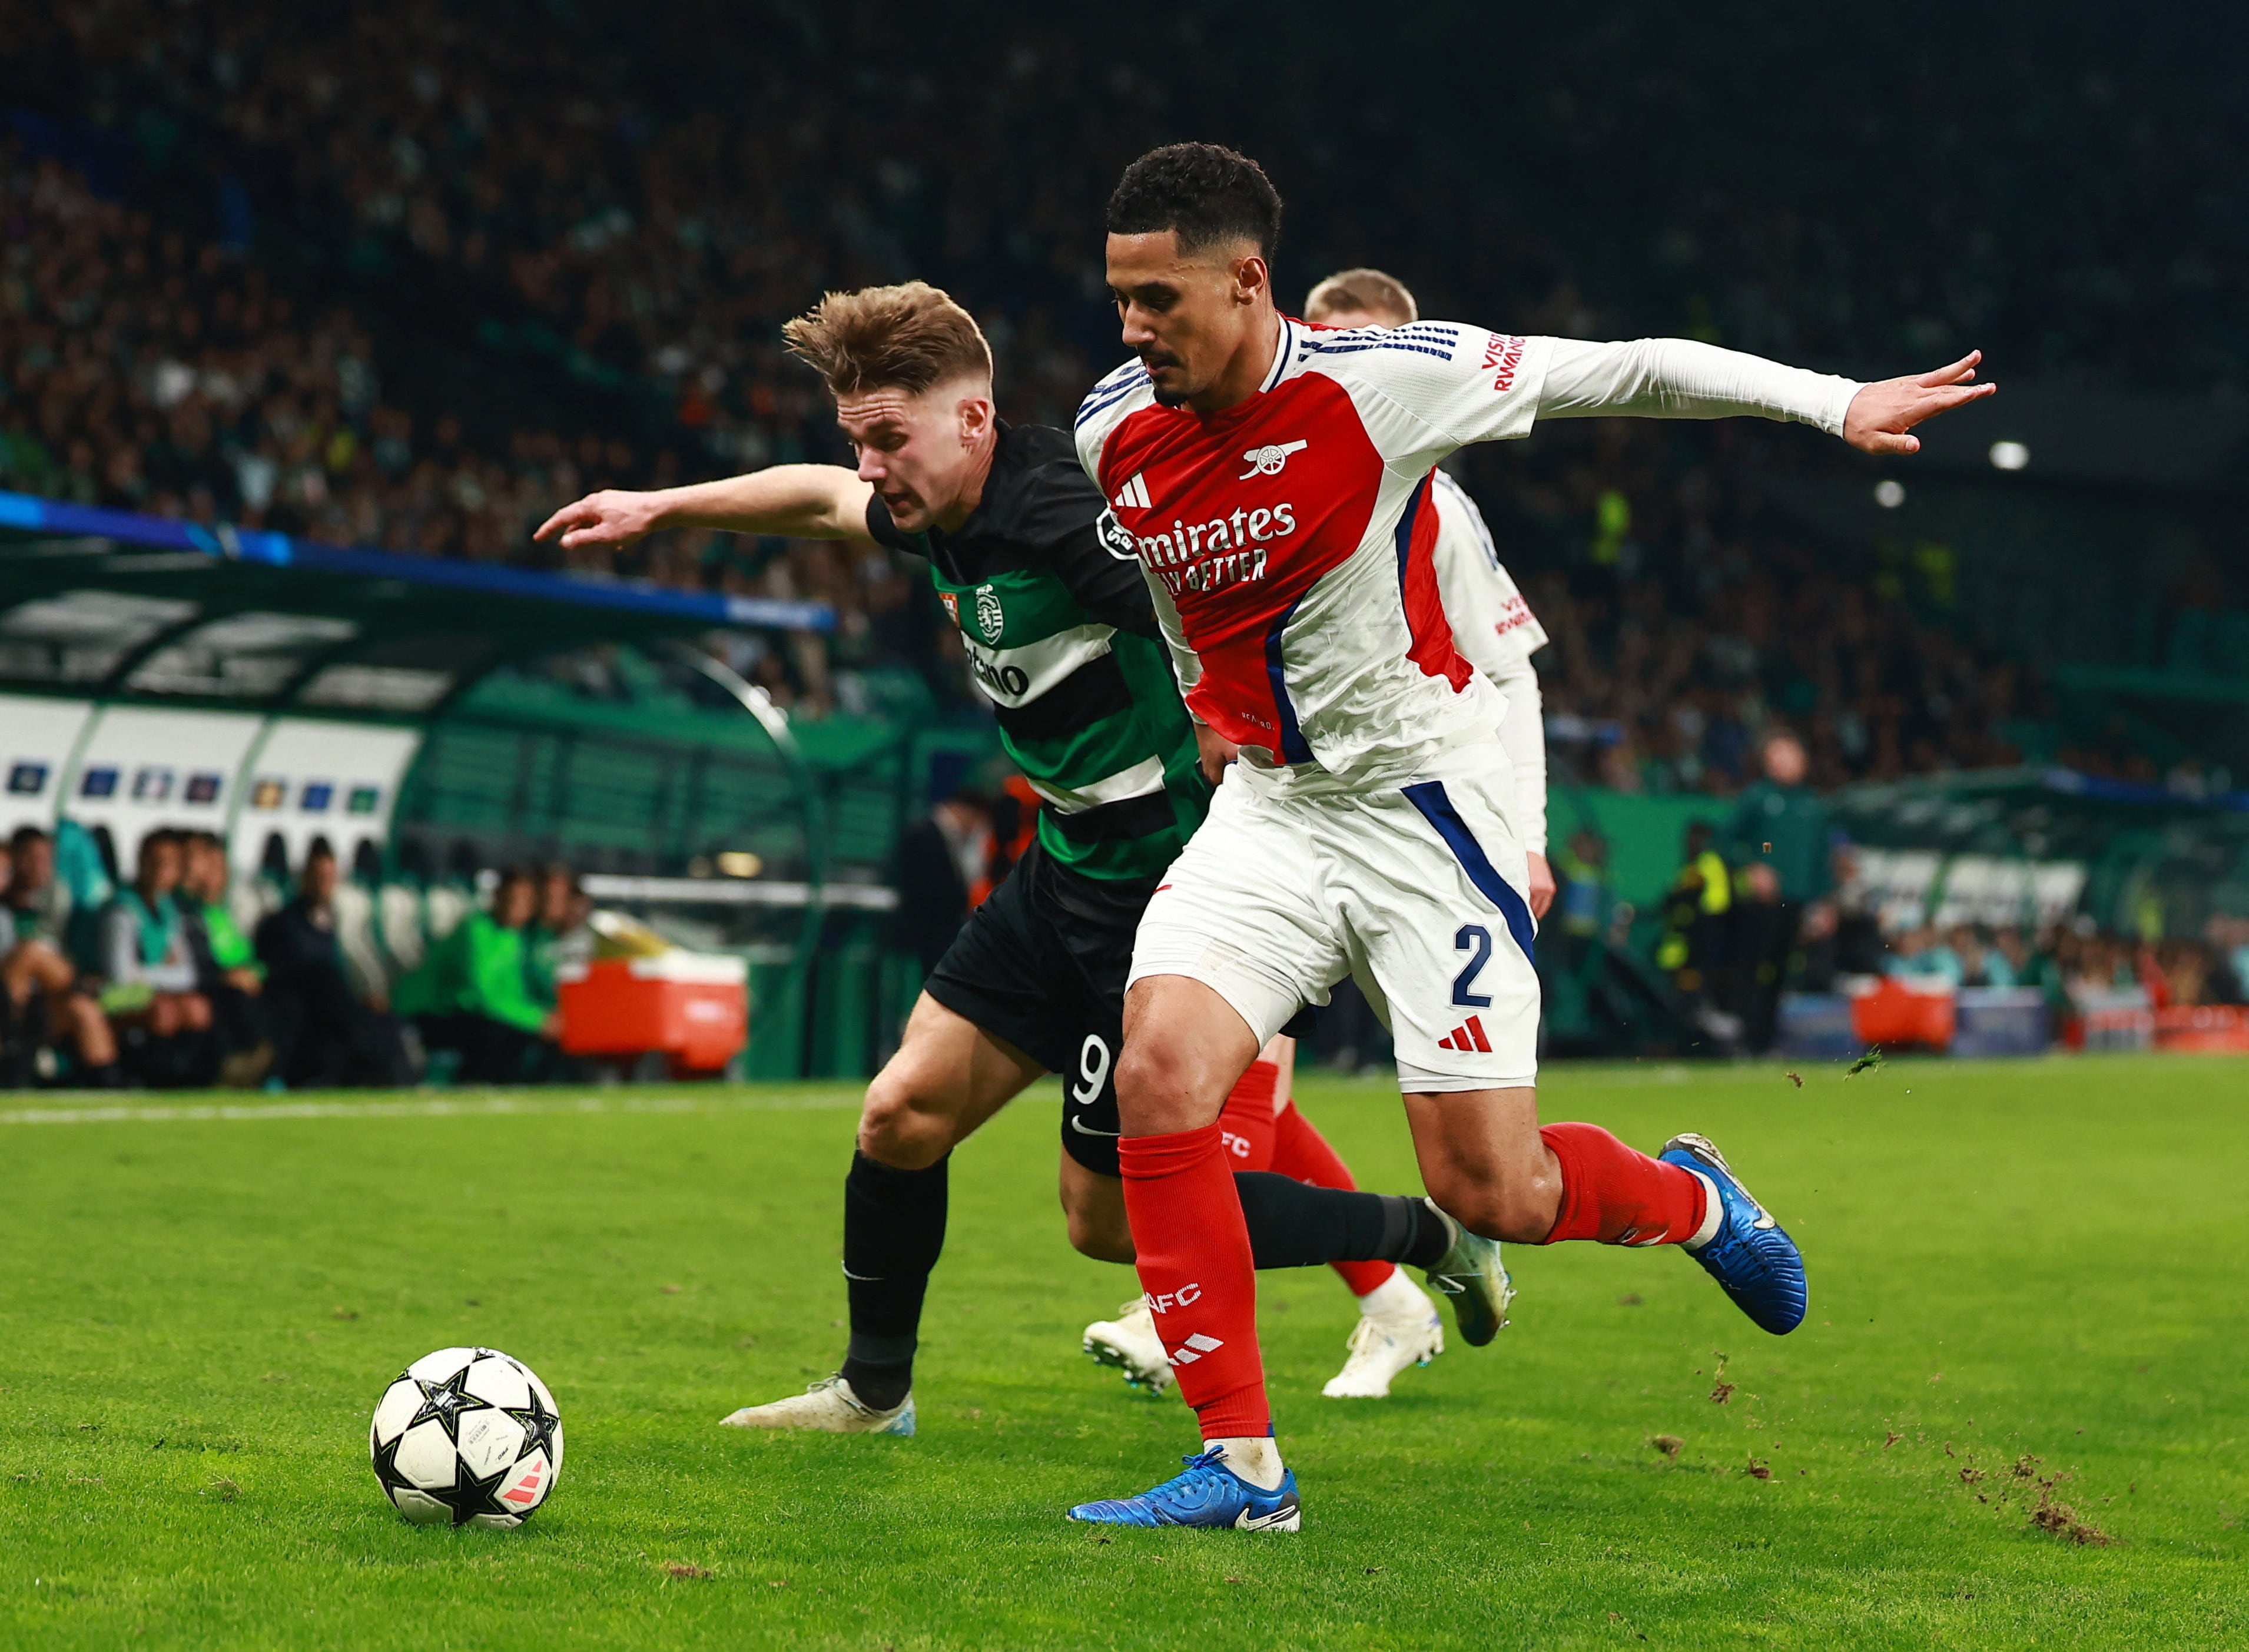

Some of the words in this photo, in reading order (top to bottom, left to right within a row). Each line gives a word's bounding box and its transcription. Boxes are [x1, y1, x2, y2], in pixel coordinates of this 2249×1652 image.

[1136, 503, 1296, 568] mirates
[1450, 922, 1494, 1010] 2
[1072, 1034, 1110, 1105] 9
[1222, 1131, 1251, 1159] FC
[1145, 1282, 1202, 1314] AFC
